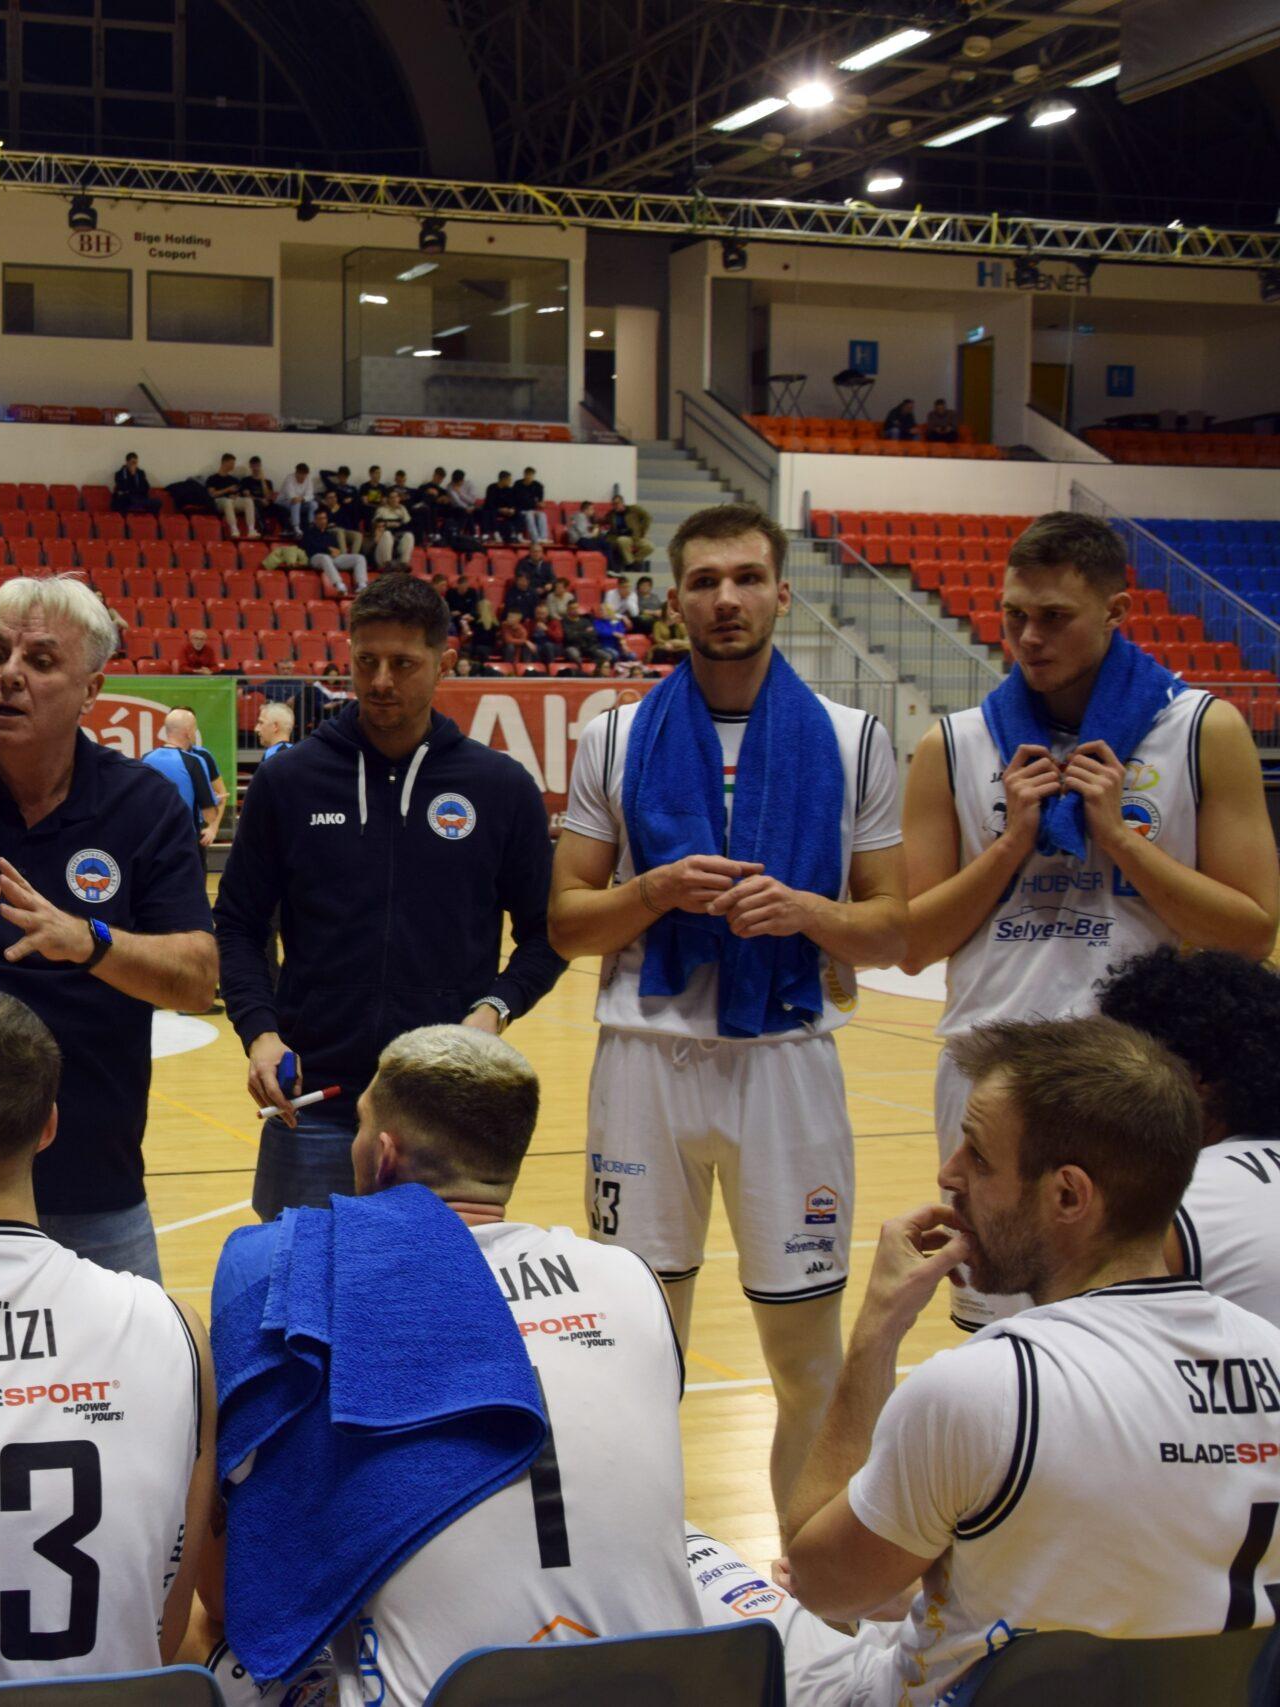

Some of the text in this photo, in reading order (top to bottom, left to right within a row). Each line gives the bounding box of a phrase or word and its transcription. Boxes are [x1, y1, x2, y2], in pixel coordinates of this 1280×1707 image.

[79, 234, 111, 253] BH
[134, 232, 211, 247] Bige Holding
[149, 248, 196, 260] Csoport
[1005, 272, 1090, 293] HBNER
[310, 813, 346, 826] JAKO
[499, 1252, 580, 1302] JÁN
[570, 1330, 602, 1342] power
[75, 1402, 111, 1414] power
[91, 1411, 124, 1424] yours!
[1159, 1442, 1280, 1465] BLADESP
